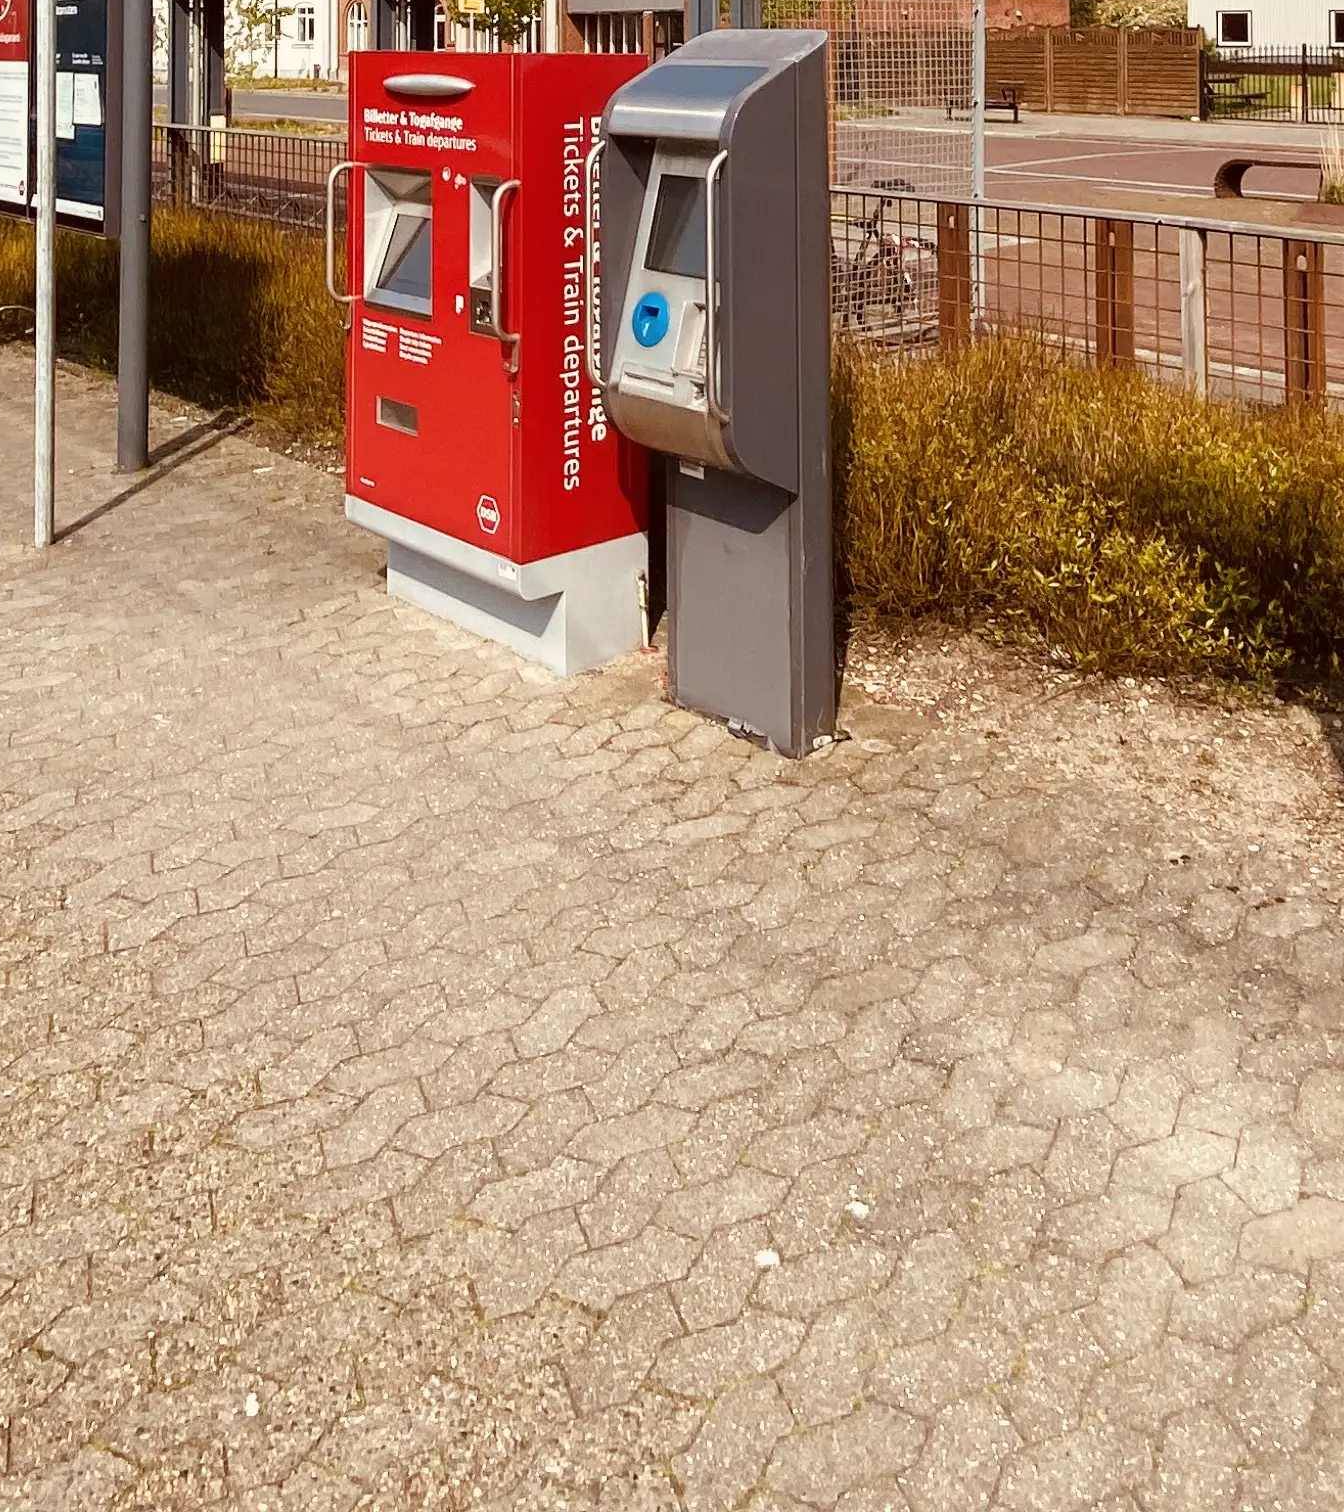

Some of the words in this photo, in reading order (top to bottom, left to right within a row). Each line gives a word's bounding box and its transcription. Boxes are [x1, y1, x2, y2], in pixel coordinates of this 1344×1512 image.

[363, 108, 399, 125] Billetter
[399, 111, 408, 126] &
[408, 112, 463, 131] Togafgange
[364, 126, 394, 144] Tickets
[394, 129, 402, 144] &
[403, 130, 426, 147] Train
[426, 132, 477, 151] departures
[563, 117, 585, 217] Tickets
[563, 226, 584, 248] &
[563, 255, 584, 325] Train
[559, 335, 585, 491] departures
